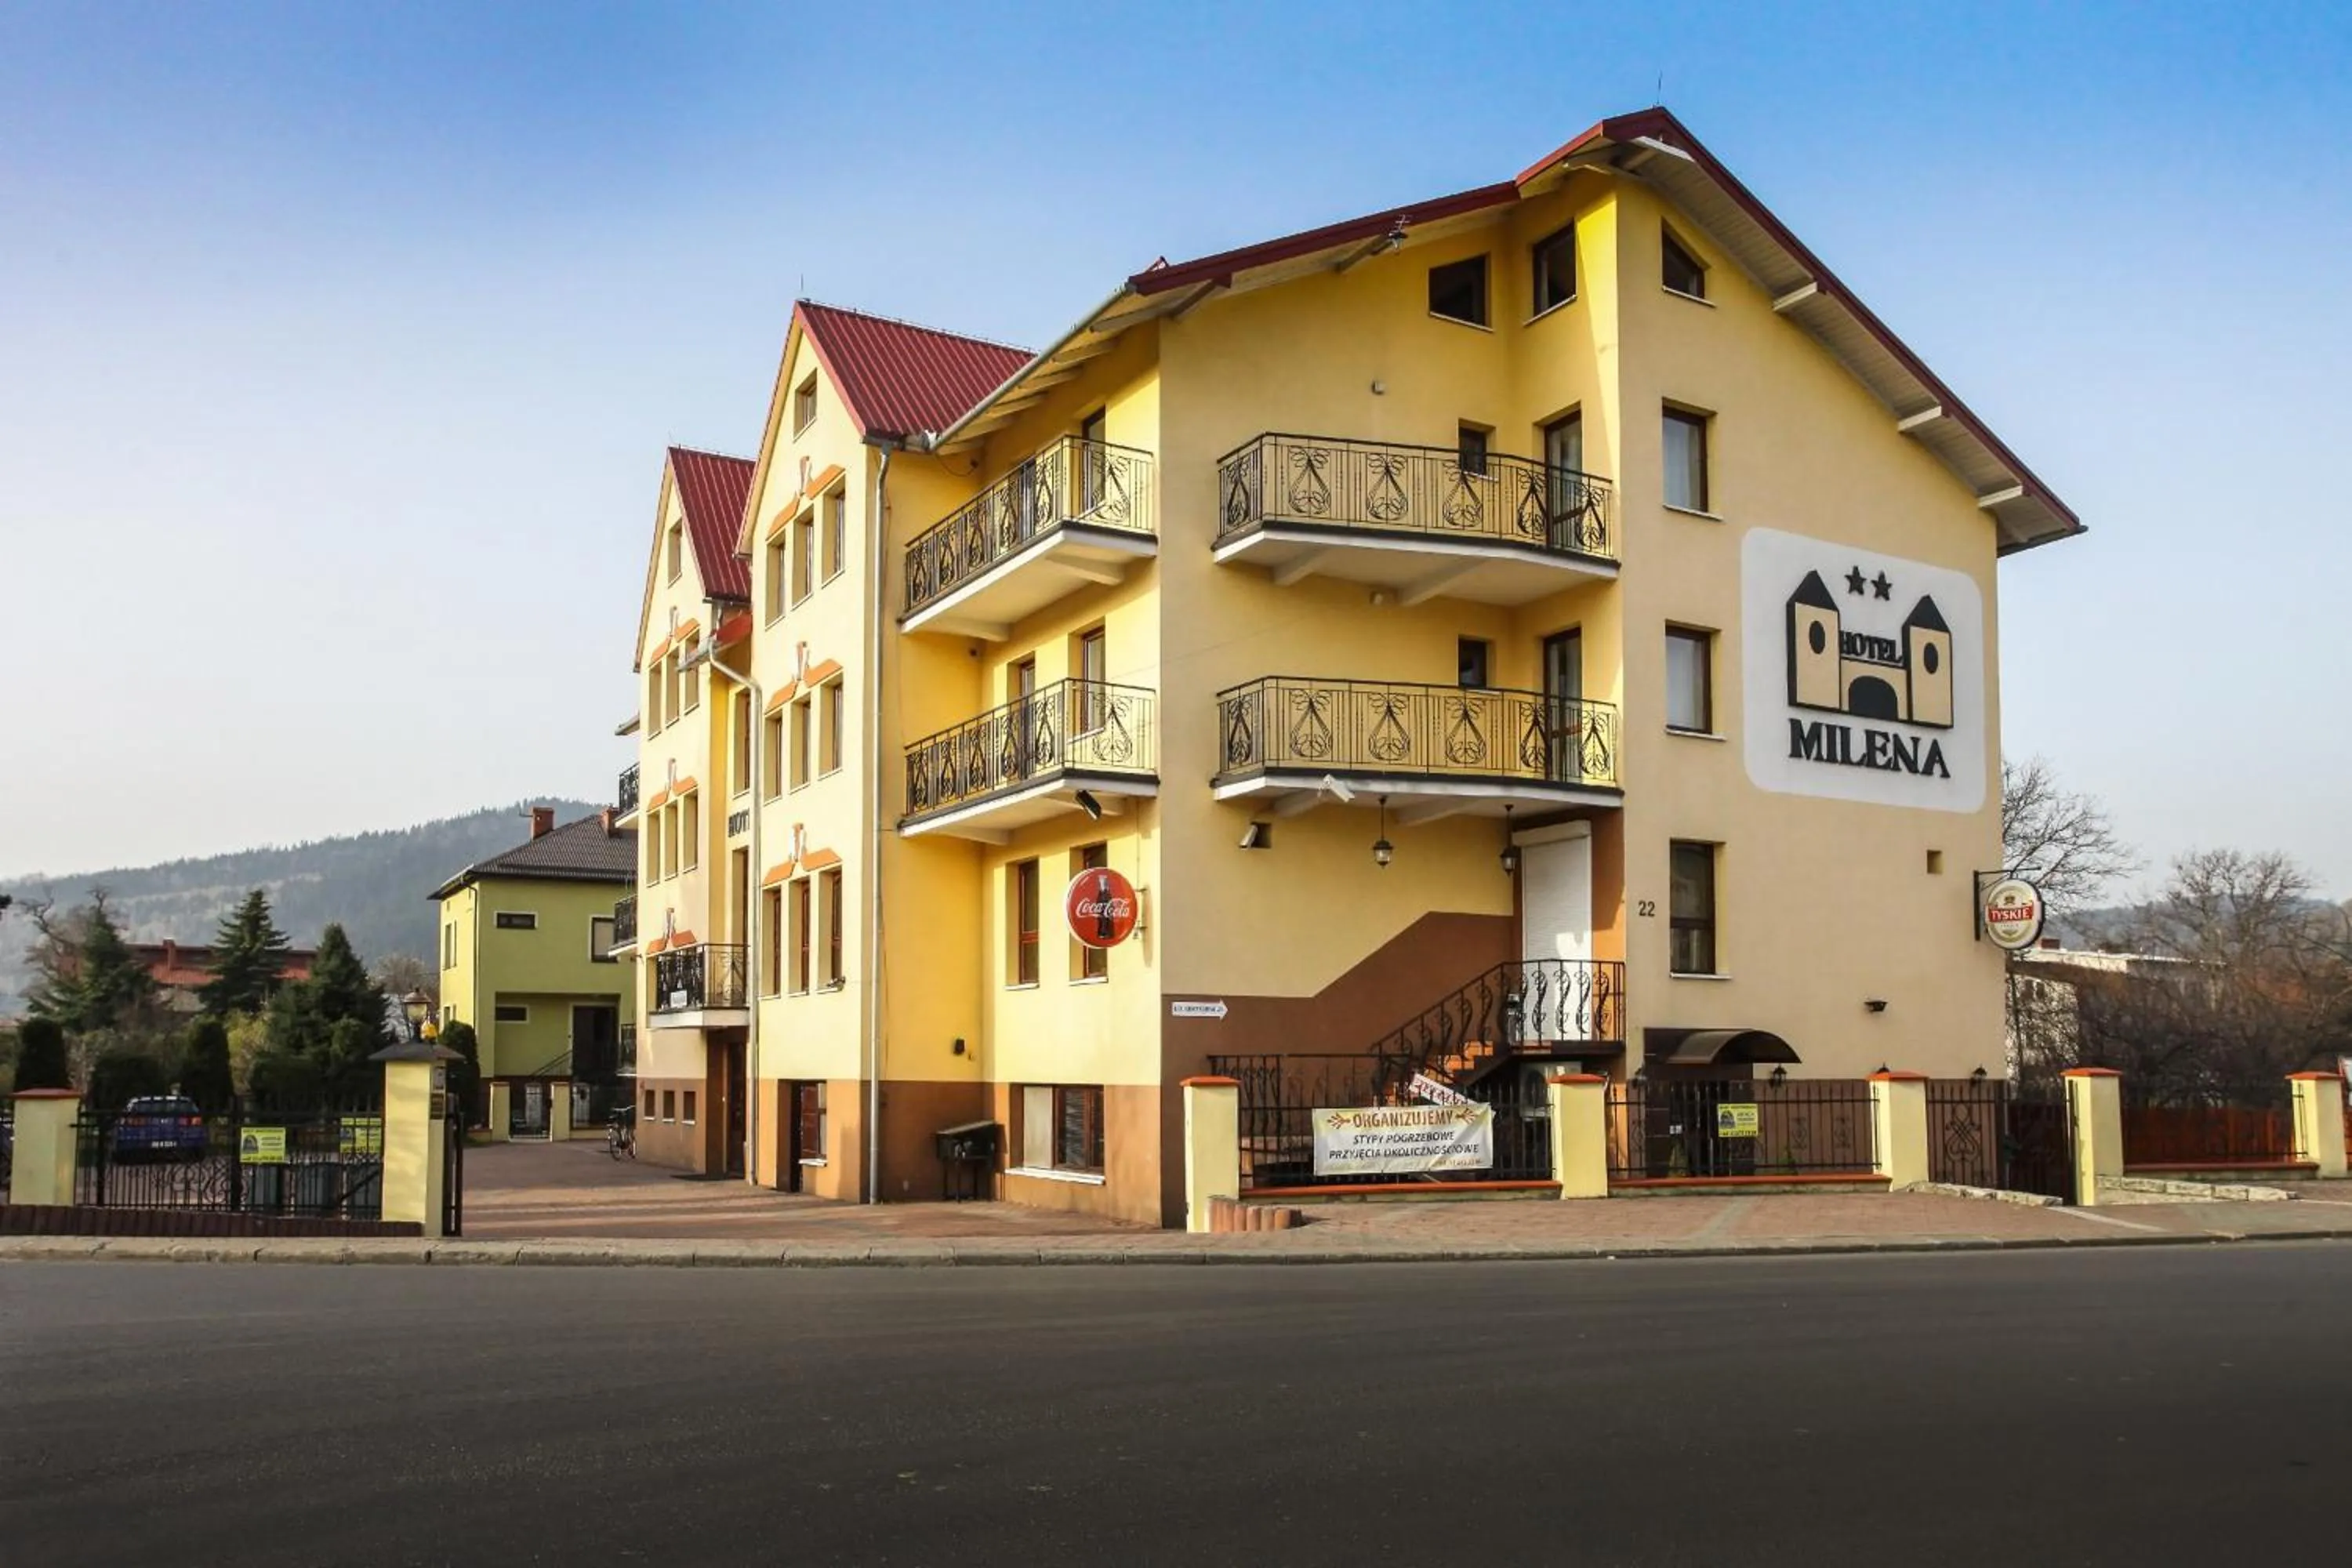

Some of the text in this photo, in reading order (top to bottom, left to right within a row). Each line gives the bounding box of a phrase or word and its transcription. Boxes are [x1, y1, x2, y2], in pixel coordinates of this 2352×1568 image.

[1840, 630, 1904, 663] HOTEL
[1788, 718, 1951, 778] MILENA
[1076, 897, 1131, 918] Coca-Cola
[1639, 900, 1655, 917] 22
[1991, 907, 2031, 920] TYSKIE
[1353, 1110, 1453, 1128] ORGANIZUJEMY
[1353, 1131, 1455, 1145] STYPY POGRZEBOWE
[1329, 1143, 1479, 1160] PRZYJĘCIA OKOLICZNOŚCIOWE
